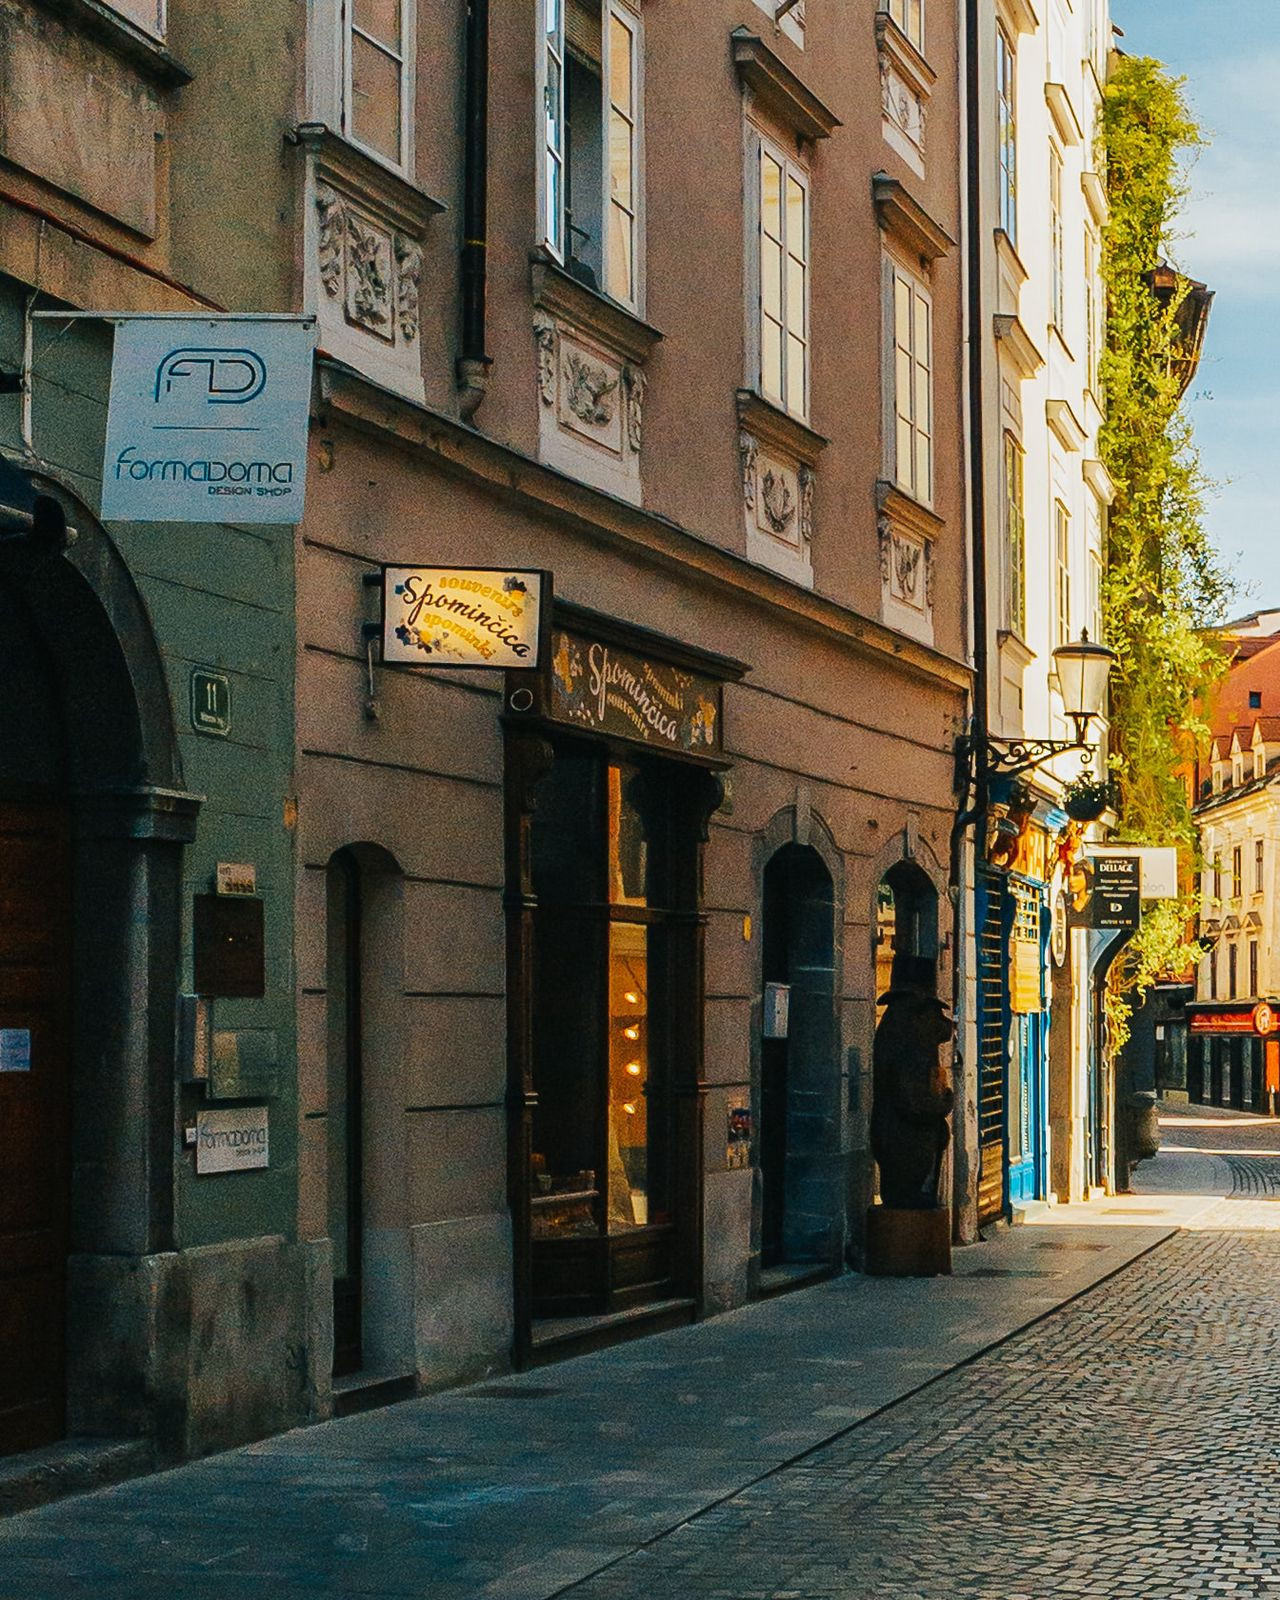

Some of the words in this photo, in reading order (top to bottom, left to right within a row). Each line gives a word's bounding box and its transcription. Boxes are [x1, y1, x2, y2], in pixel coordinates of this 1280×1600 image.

[208, 486, 252, 496] DESIGN
[256, 487, 292, 497] SHOP
[402, 575, 531, 658] Spominčica
[206, 682, 217, 713] 11
[589, 643, 678, 741] Spominčica
